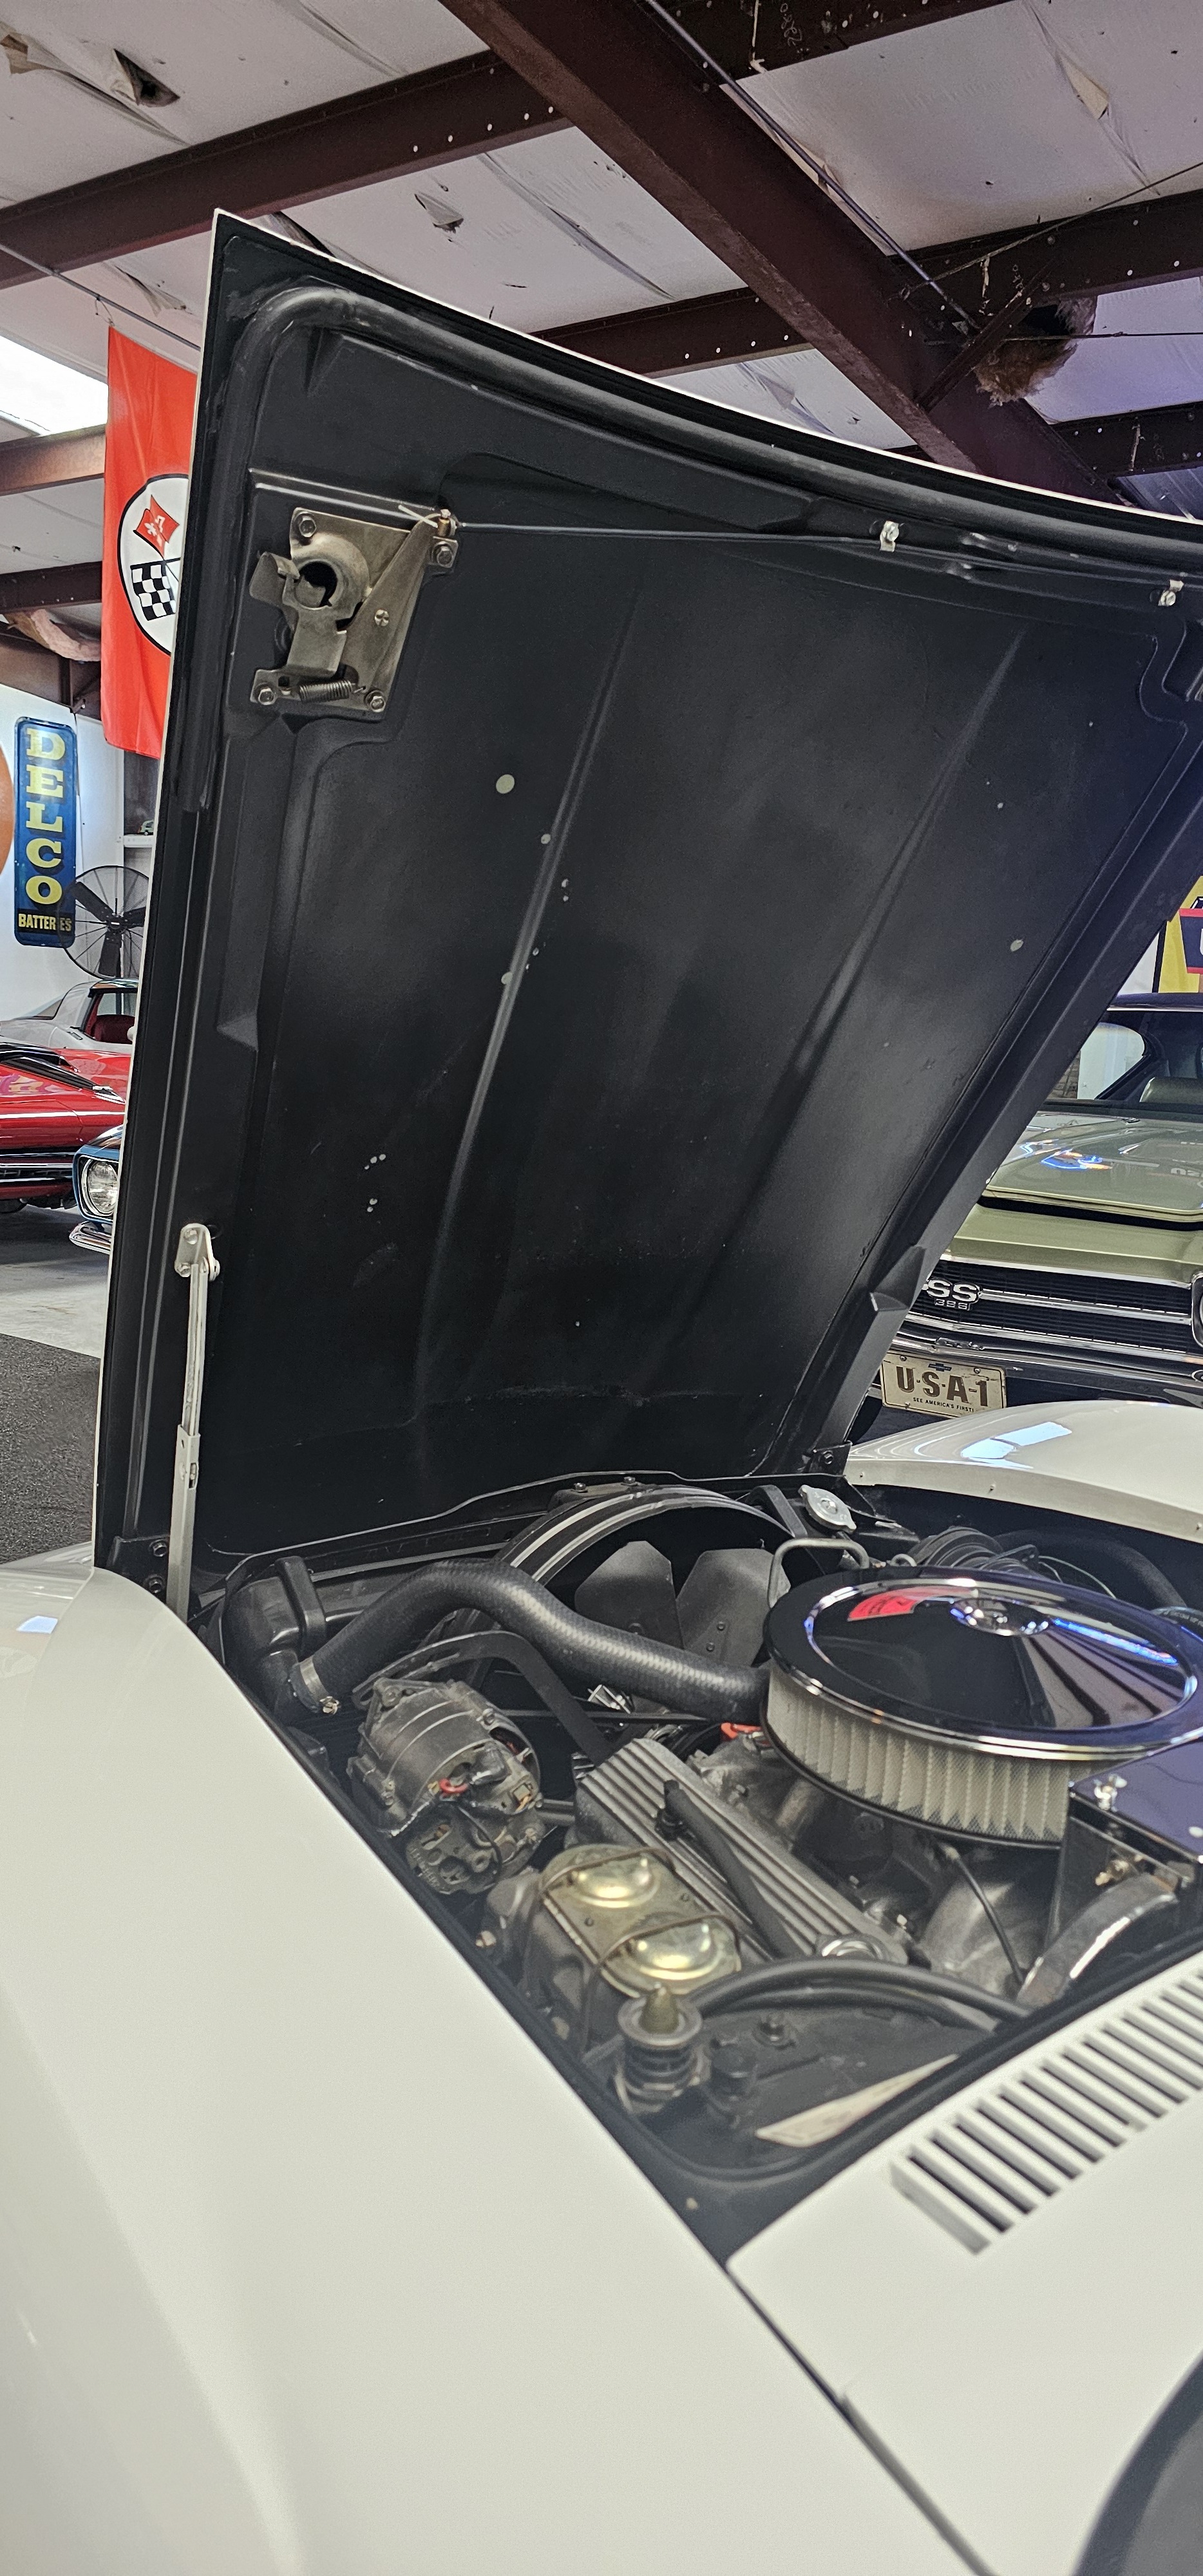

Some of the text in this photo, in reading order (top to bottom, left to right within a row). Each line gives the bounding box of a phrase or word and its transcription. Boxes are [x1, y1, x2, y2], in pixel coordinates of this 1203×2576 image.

[26, 728, 66, 904] DELCO
[18, 913, 72, 932] BATTERES
[926, 1280, 978, 1302] SS
[934, 1298, 968, 1310] 396
[925, 1399, 954, 1408] AMERICA'S
